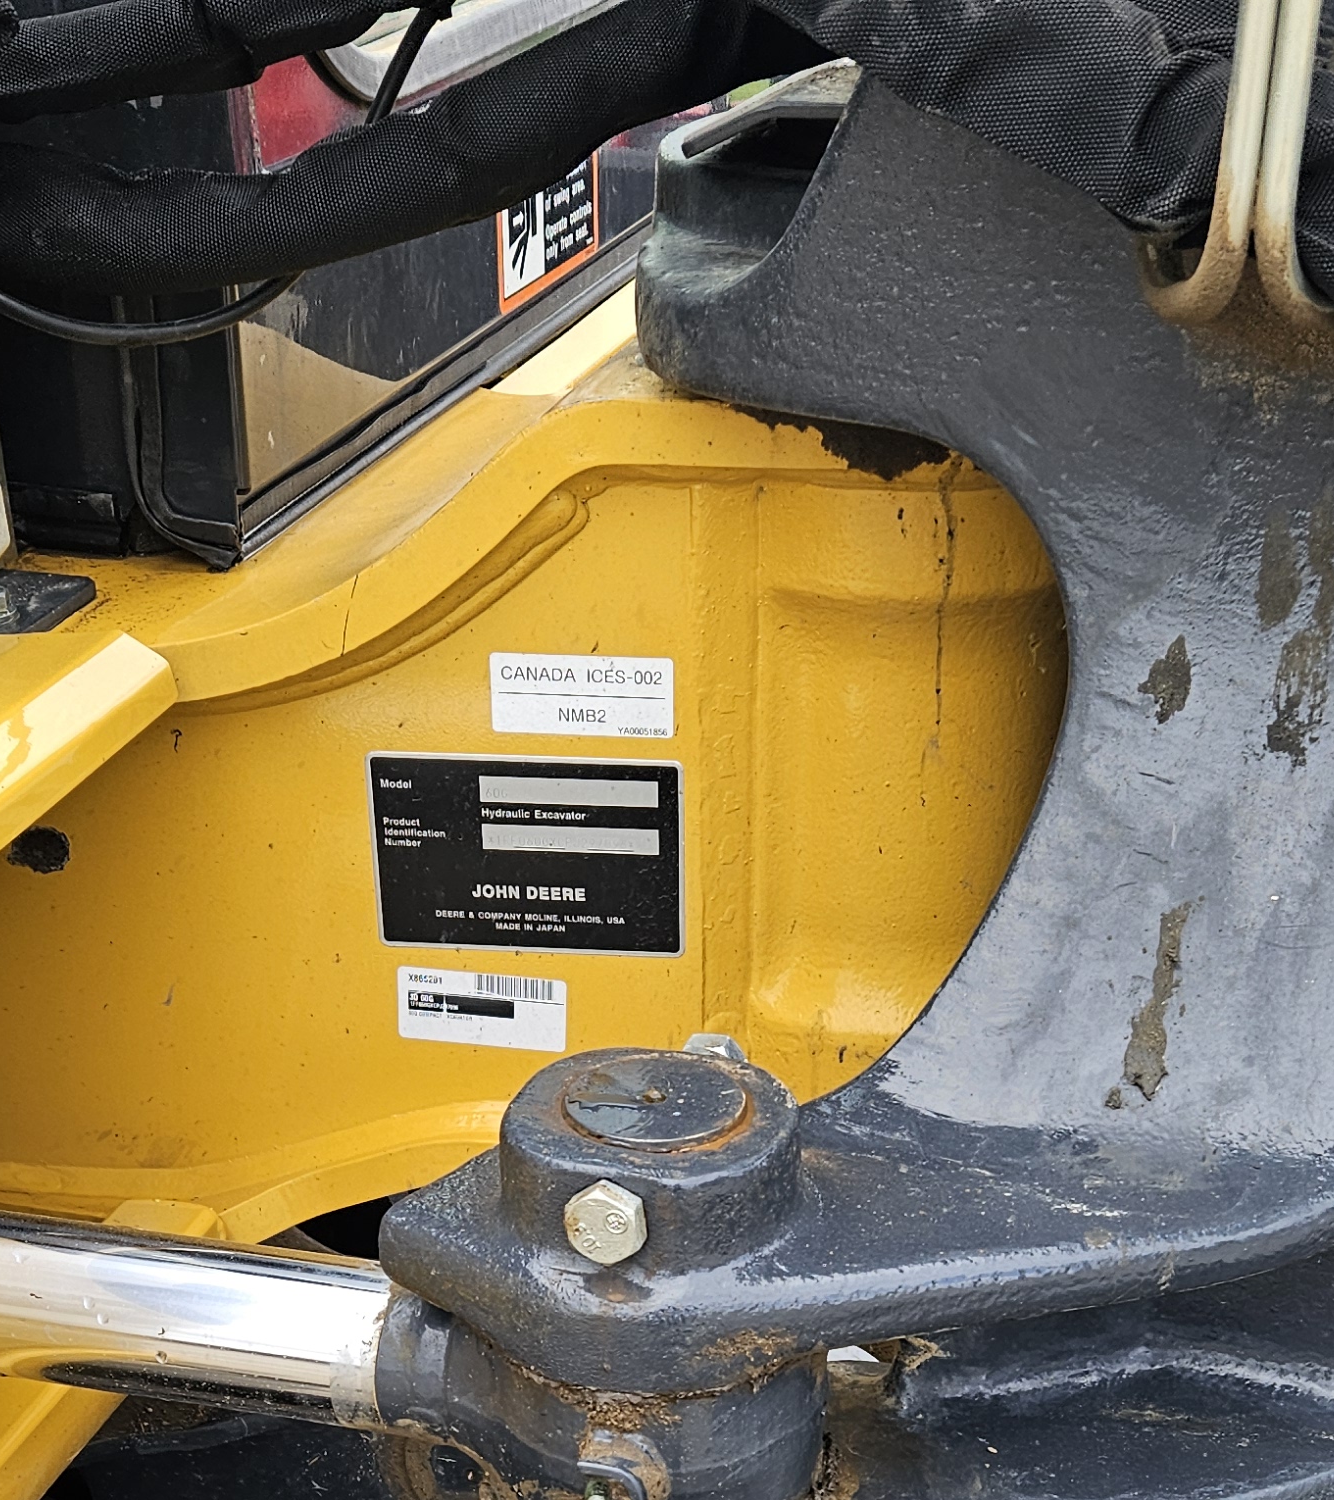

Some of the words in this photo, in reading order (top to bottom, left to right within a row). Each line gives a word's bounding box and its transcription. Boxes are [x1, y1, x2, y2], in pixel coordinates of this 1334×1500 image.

[560, 232, 574, 252] from
[500, 665, 576, 683] CANADA
[587, 668, 662, 685] ICES-002
[558, 707, 607, 723] NMB2
[617, 727, 668, 736] YA00051856
[380, 778, 412, 789] Model
[481, 808, 530, 819] Hydraulic
[534, 810, 587, 821] Excavator
[383, 817, 421, 827] Product
[384, 827, 446, 838] Identification
[384, 838, 422, 847] Number
[471, 884, 520, 900] JOHN
[526, 885, 587, 902] DEERE
[435, 909, 465, 919] DEERE
[468, 911, 475, 919] &
[478, 911, 522, 921] COMPANY
[524, 913, 561, 923] MOLINE,
[563, 915, 604, 925] ILLINOIS,
[606, 916, 625, 925] USA
[495, 922, 521, 931] MADE
[524, 923, 533, 931] IN
[536, 923, 566, 932] JAPAN
